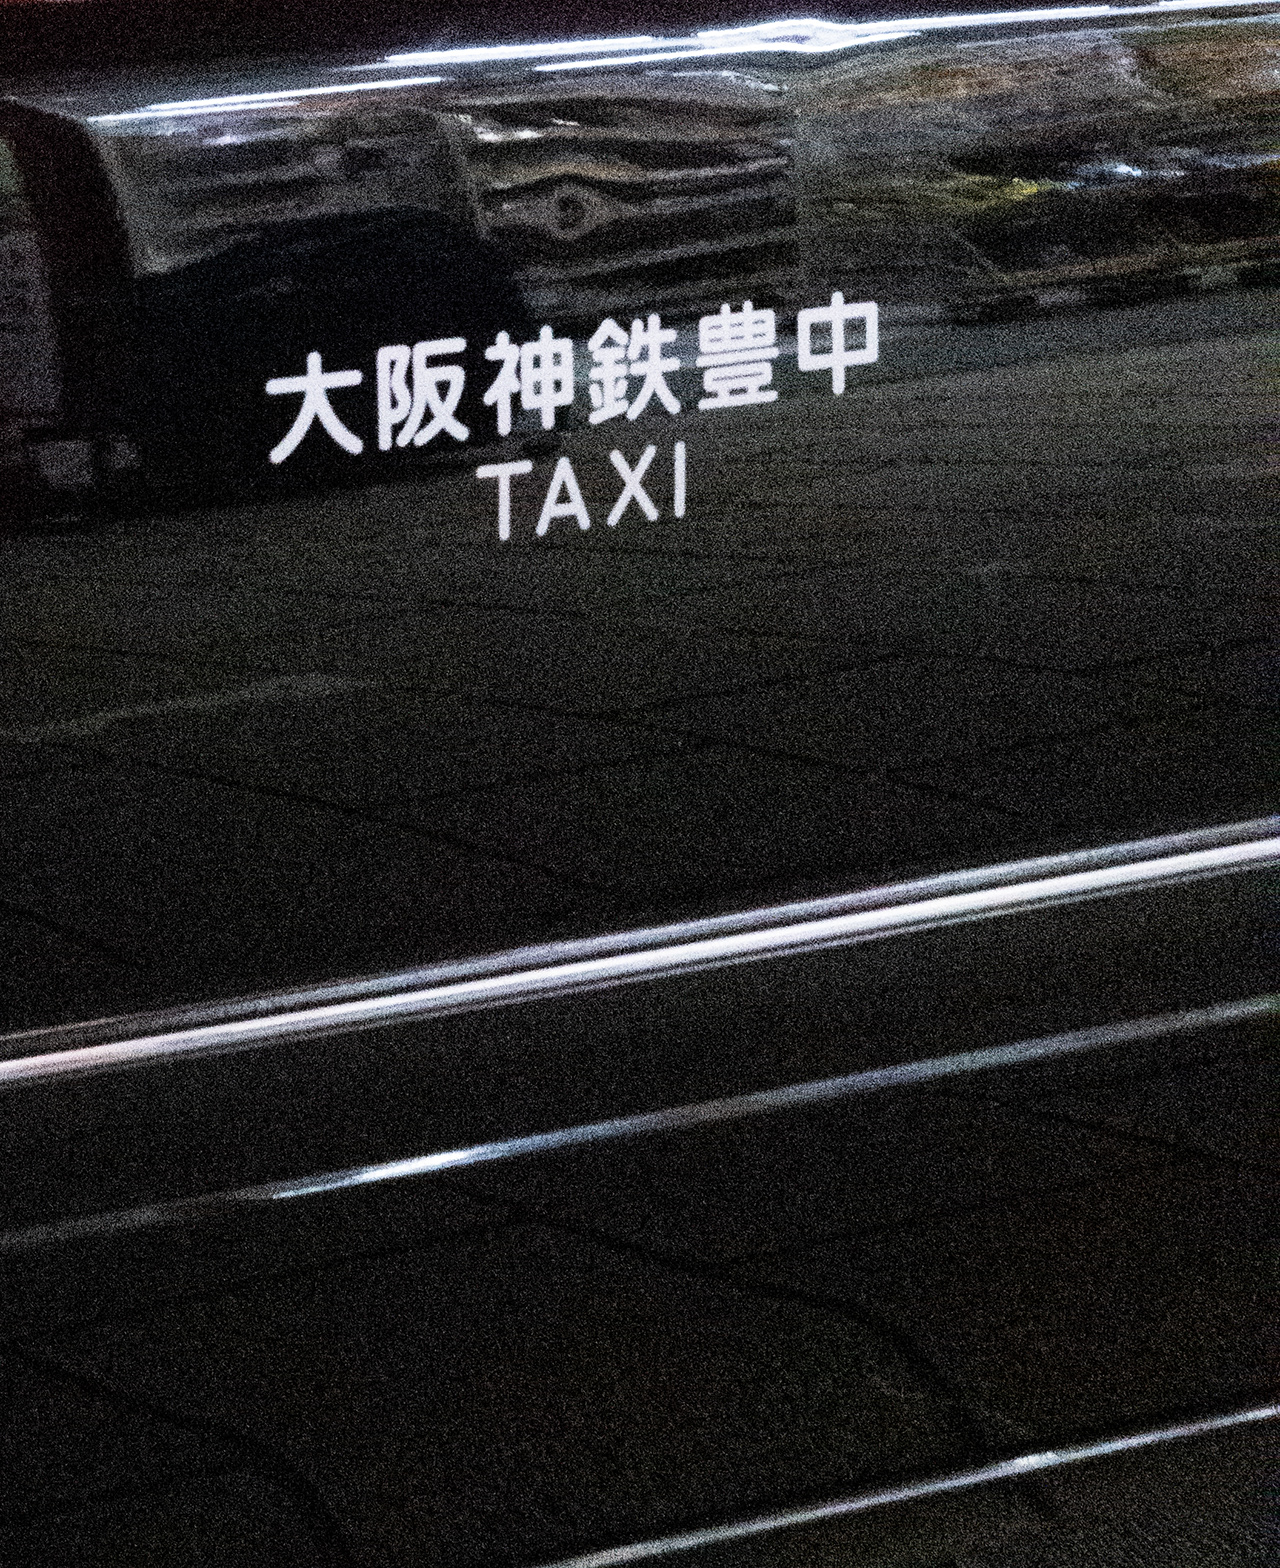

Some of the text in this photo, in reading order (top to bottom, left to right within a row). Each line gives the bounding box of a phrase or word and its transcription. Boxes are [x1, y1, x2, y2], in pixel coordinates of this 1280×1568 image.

[264, 290, 880, 464] 大阪神鉄豊中
[475, 440, 687, 542] TAXI
